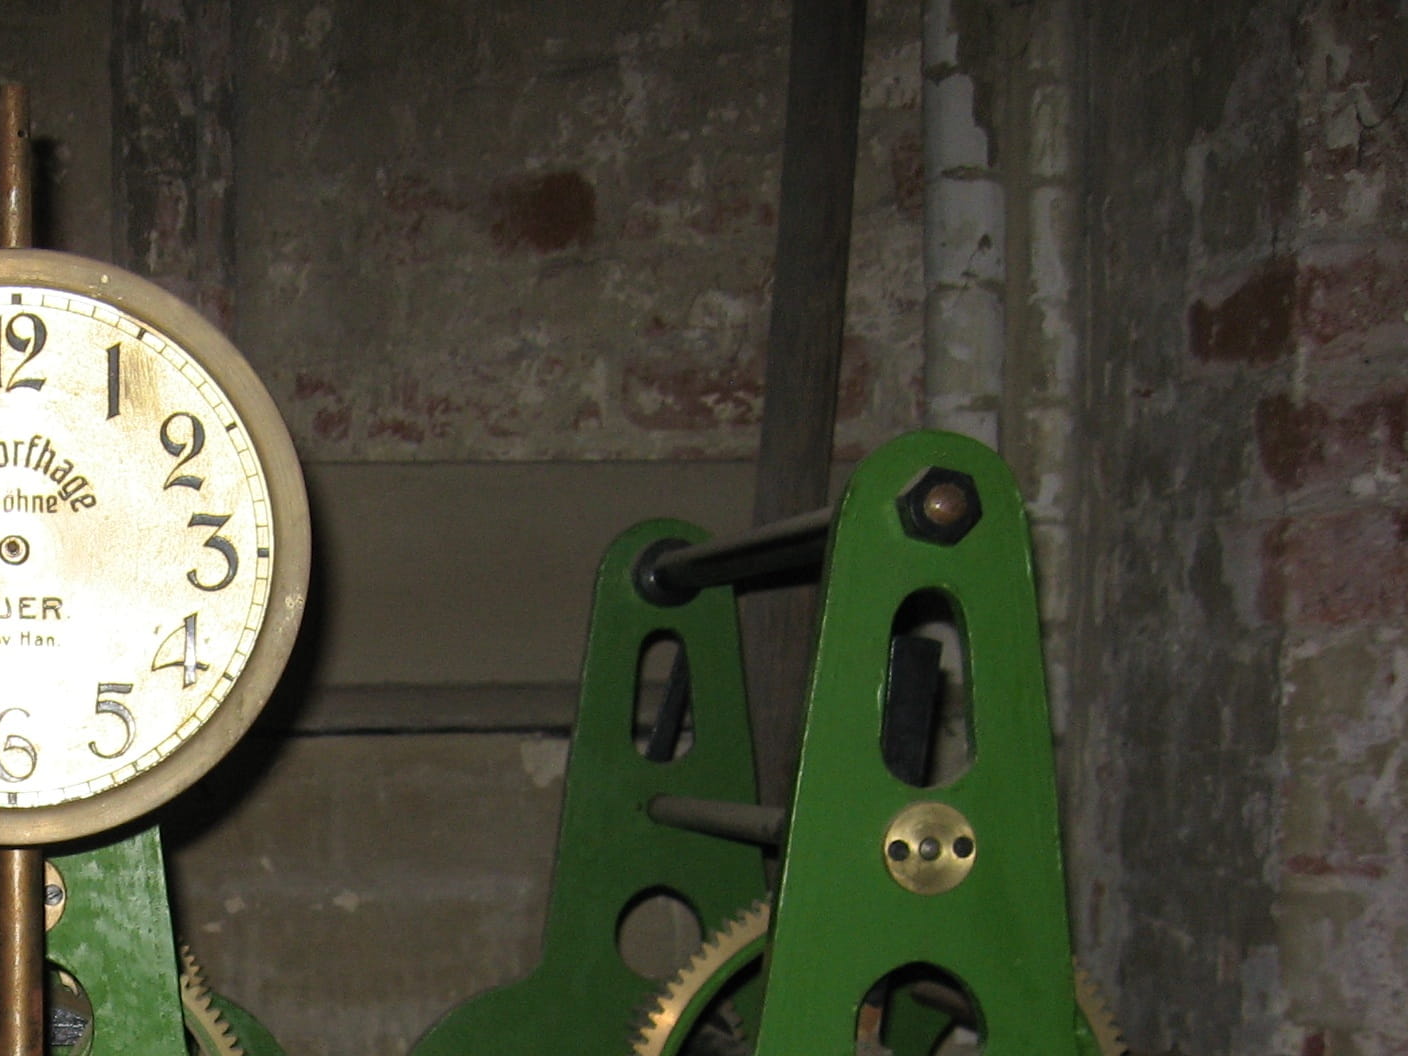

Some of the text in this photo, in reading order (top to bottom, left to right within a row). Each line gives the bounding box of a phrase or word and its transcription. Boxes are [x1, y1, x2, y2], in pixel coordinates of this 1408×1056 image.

[105, 342, 122, 420] 1
[160, 412, 206, 491] 2
[186, 513, 239, 592] 3
[151, 612, 209, 690] 4
[88, 683, 136, 760] 5
